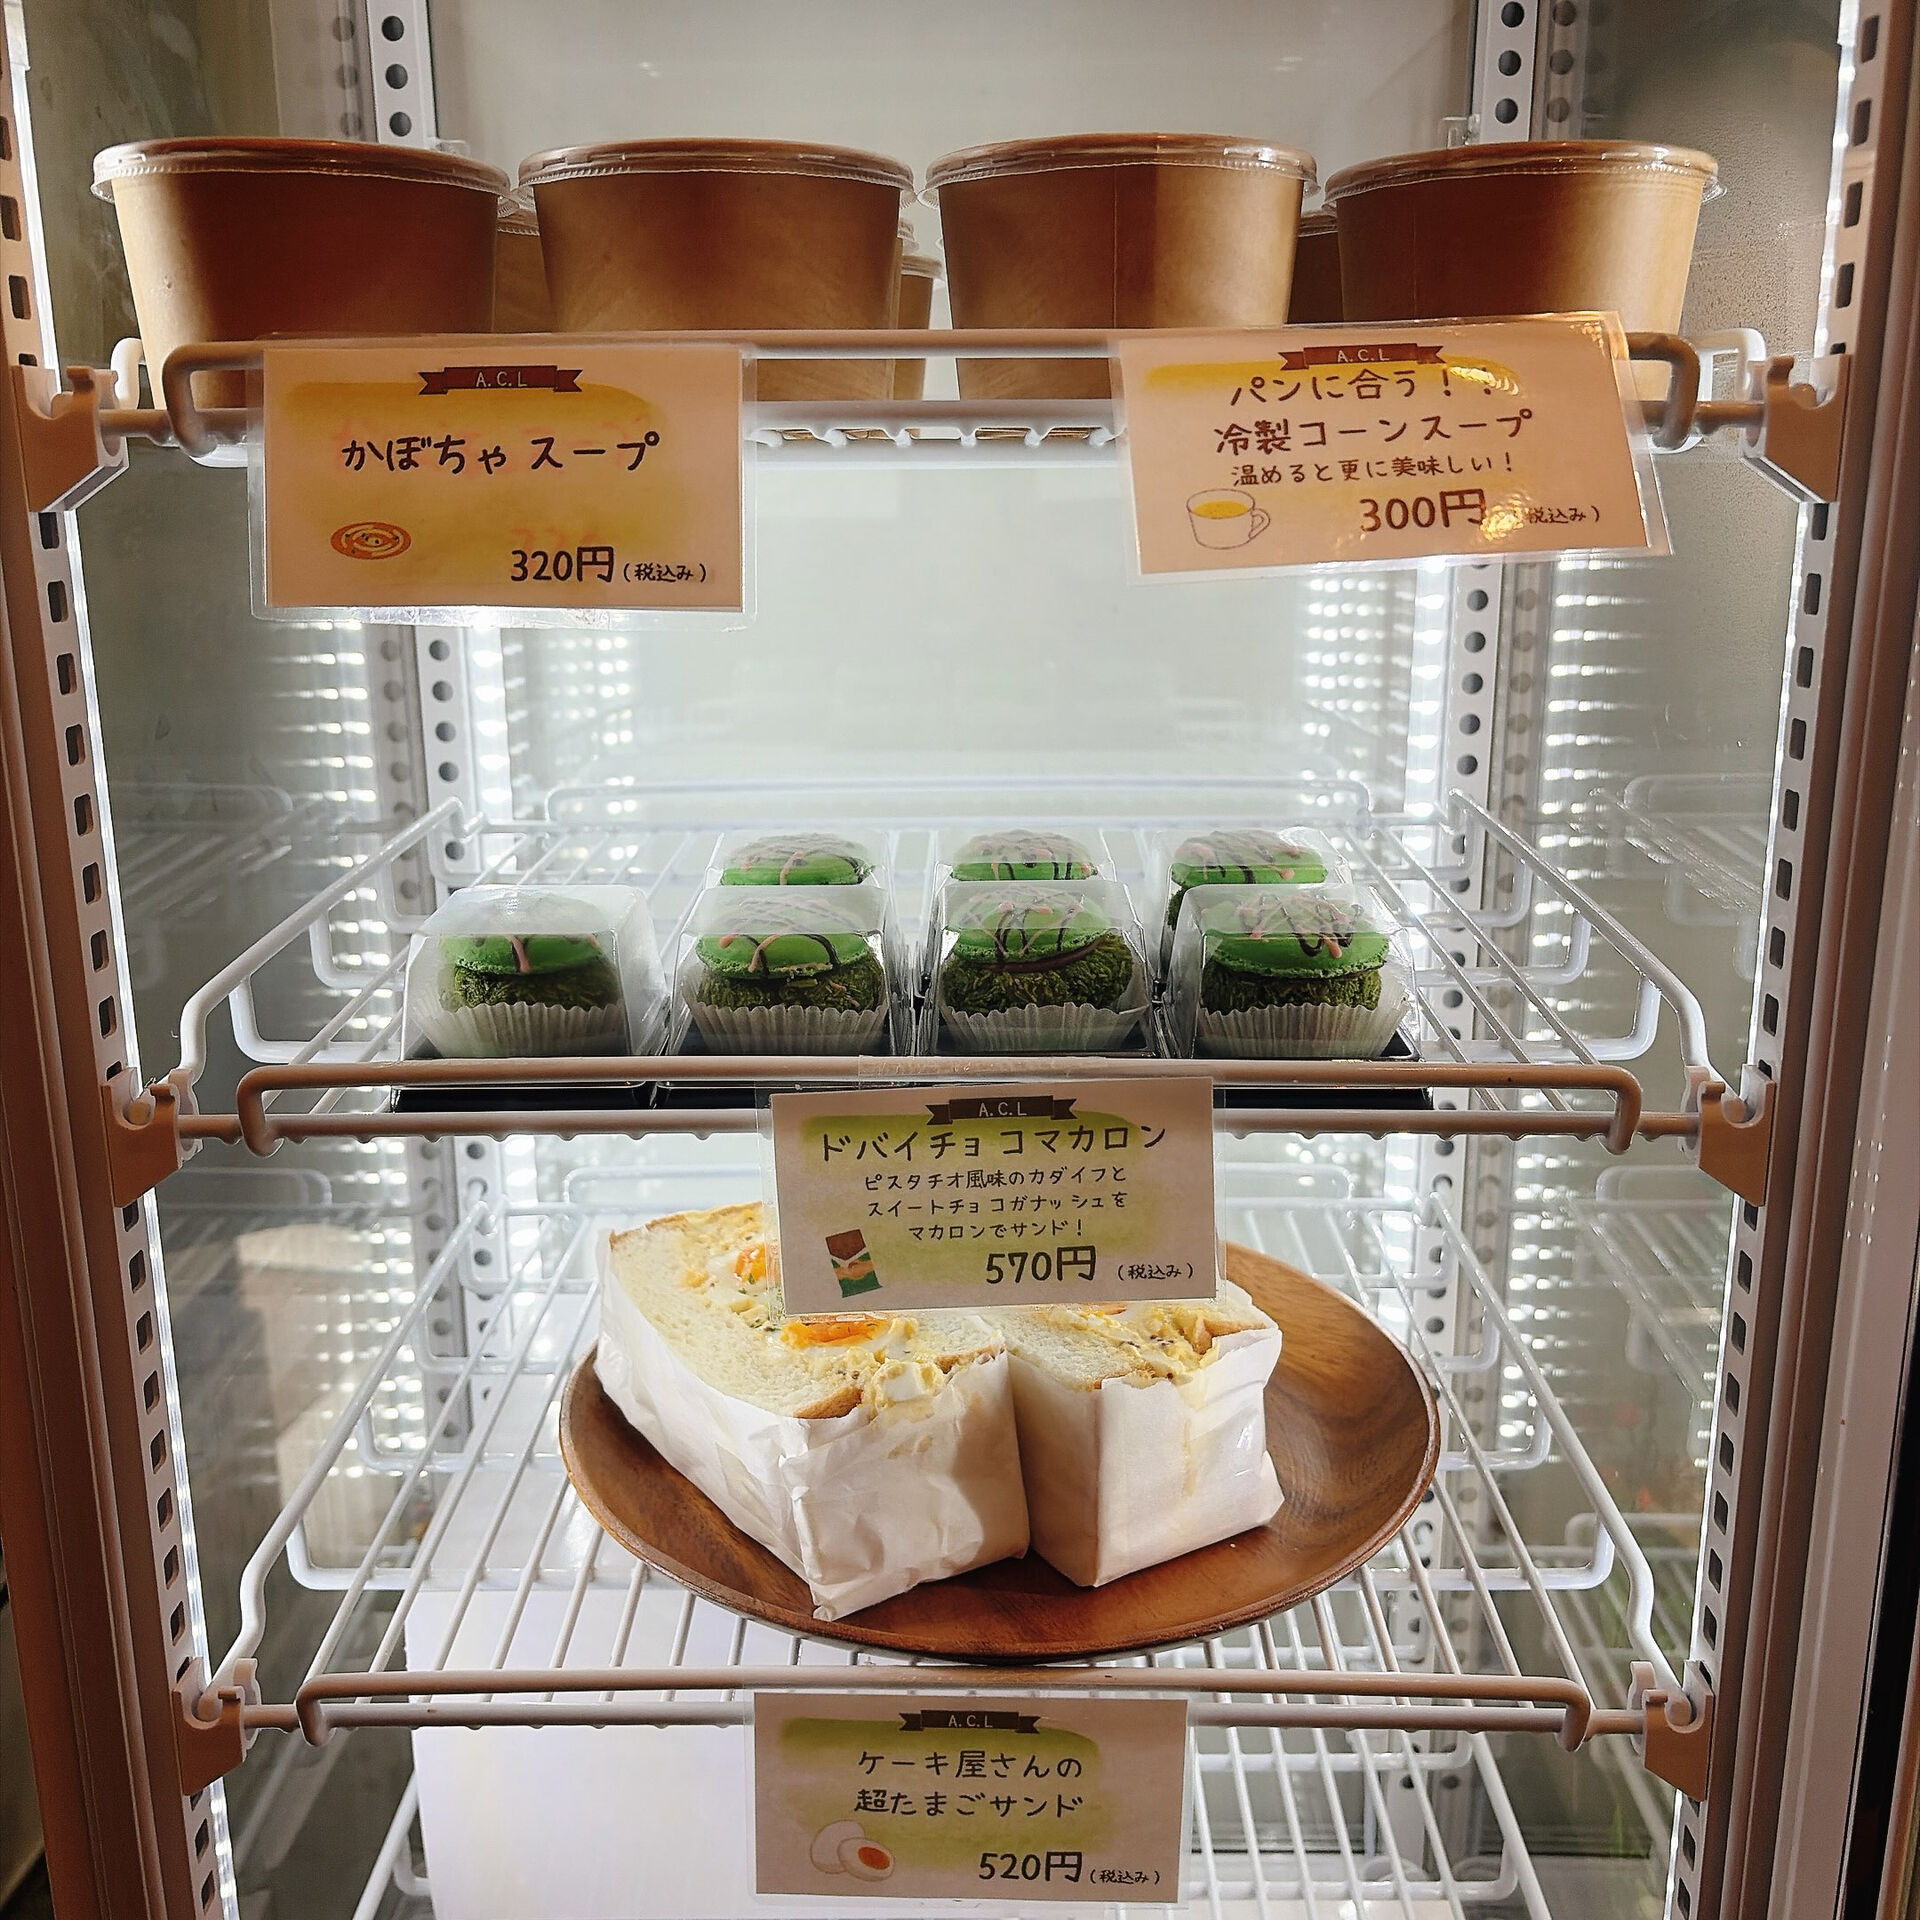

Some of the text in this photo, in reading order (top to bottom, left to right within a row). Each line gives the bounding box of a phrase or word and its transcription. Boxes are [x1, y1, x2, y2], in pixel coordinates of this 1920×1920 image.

[1337, 348, 1390, 363] A.C.L
[475, 371, 528, 388] A.C.L
[1214, 409, 1532, 455] 冷製コーンスープ
[342, 430, 660, 474] かぼちゃスープ
[1232, 455, 1514, 486] 温めると更に美味しい!
[1360, 488, 1600, 532] 300円 税込み)
[510, 546, 615, 582] 320円
[979, 1102, 1027, 1117] A.C.L
[823, 1124, 1165, 1162] ドバイチョコマカロン
[865, 1166, 1127, 1191] ピスタチオ風味のカダイフと
[868, 1191, 1127, 1217] スイートチョコガナッシュを
[908, 1219, 1083, 1241] マカロンでサンド!
[986, 1245, 1096, 1284] 570円
[948, 1714, 993, 1729] A.C.L
[858, 1750, 1082, 1779] ケーキ屋さんの
[854, 1789, 1083, 1817] 超たまごサンド
[979, 1852, 1082, 1882] 520円
